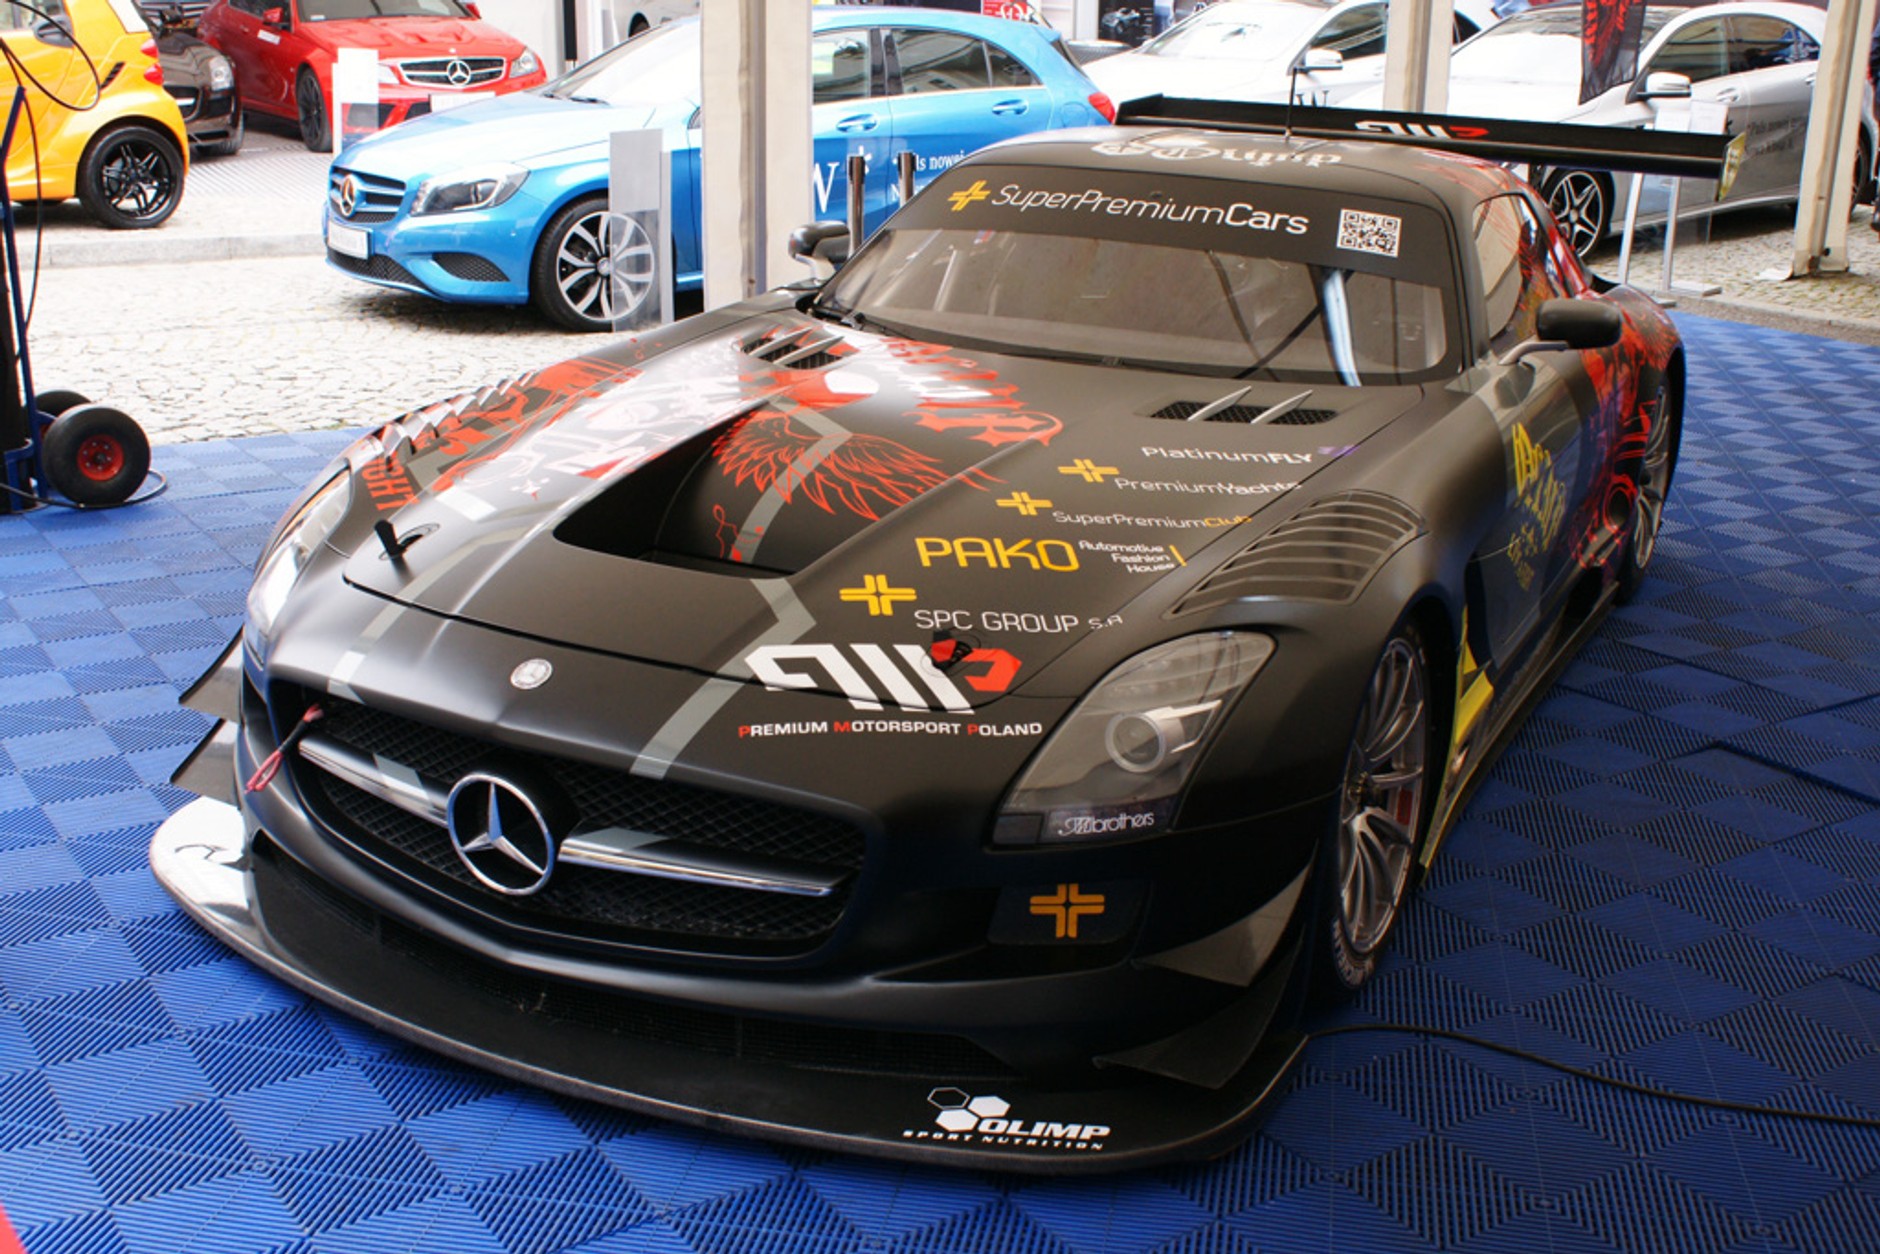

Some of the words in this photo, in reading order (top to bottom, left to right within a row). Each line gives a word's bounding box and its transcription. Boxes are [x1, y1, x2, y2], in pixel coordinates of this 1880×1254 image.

[991, 183, 1309, 235] SuperPremiumCars
[1141, 446, 1312, 464] PlatinumFLY
[1114, 477, 1302, 495] PremiumYachts
[1052, 511, 1252, 528] SuperPremiumClub
[915, 537, 1080, 571] PAKO
[1078, 540, 1164, 553] Automotive
[1111, 552, 1170, 563] Fashion
[1126, 563, 1175, 574] House
[914, 609, 973, 631] SPC
[981, 611, 1079, 633] GROUP
[738, 721, 828, 738] PREMIUM
[833, 720, 961, 735] MOTORSPORT
[967, 722, 1042, 736] POLAND
[977, 1117, 1111, 1140] OLIMP
[902, 1129, 973, 1142] SPORT
[981, 1135, 1103, 1151] NUTRITION
